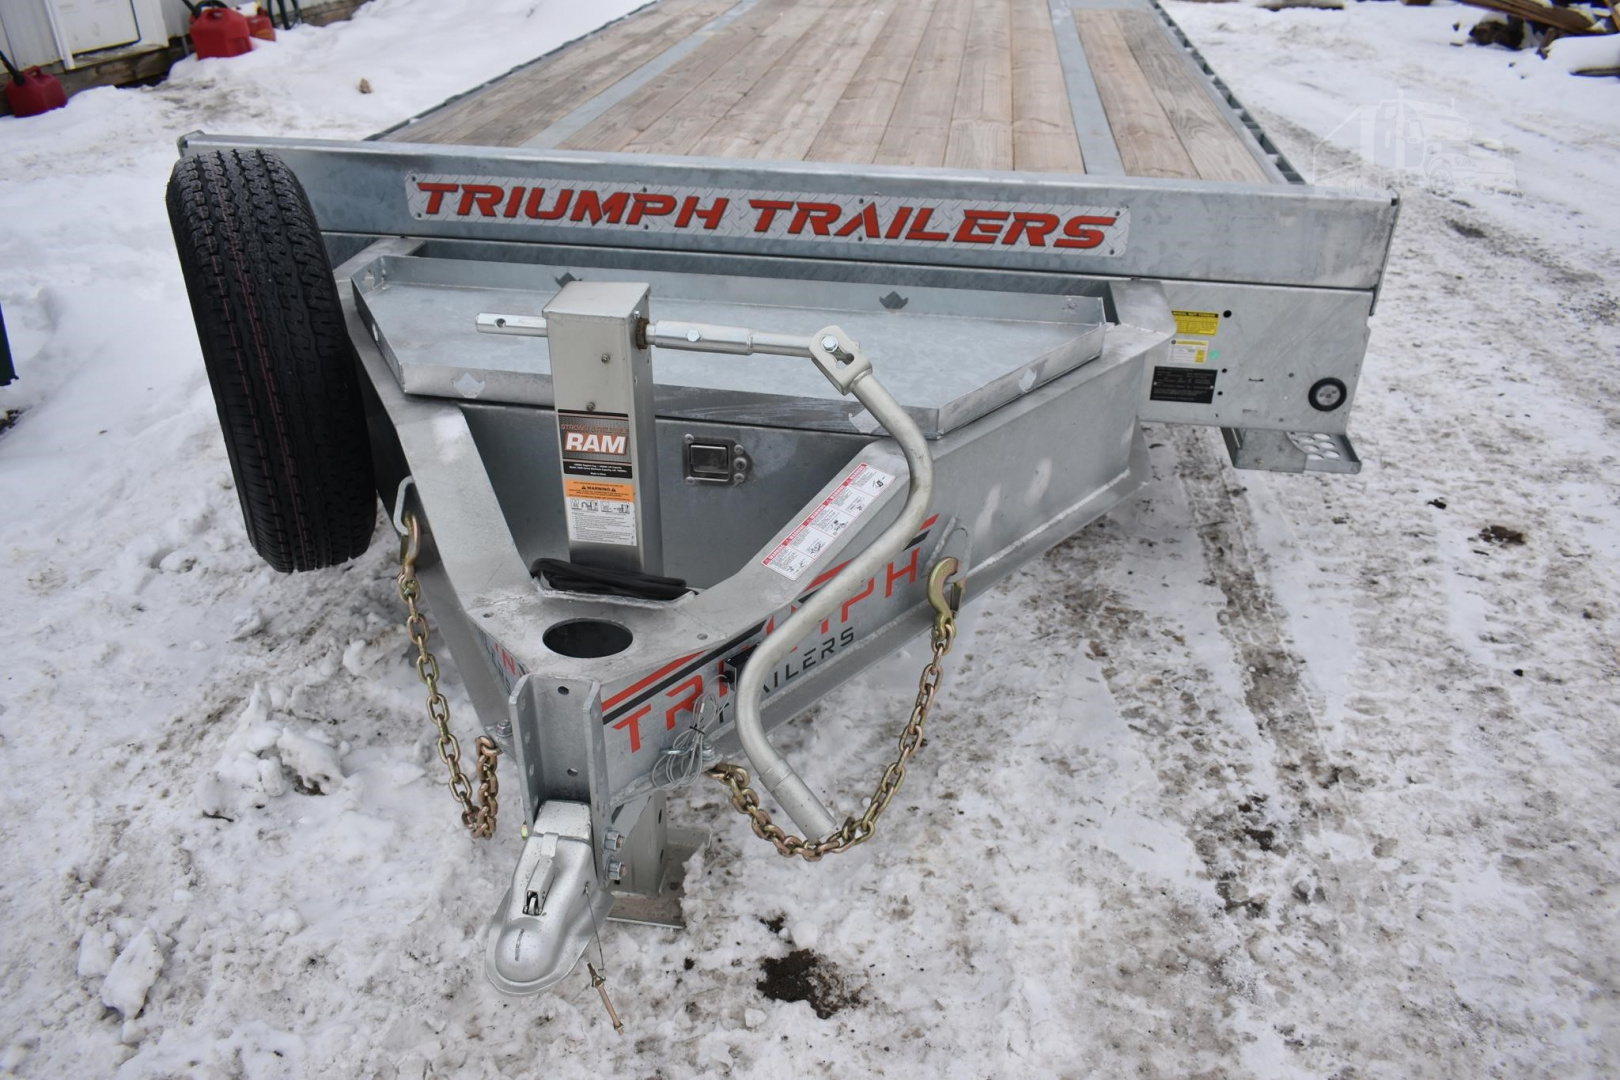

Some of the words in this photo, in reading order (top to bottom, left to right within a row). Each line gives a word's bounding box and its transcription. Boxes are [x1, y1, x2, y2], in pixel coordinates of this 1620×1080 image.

[417, 182, 730, 231] TRIUMPH
[749, 198, 1117, 250] TRAILERS
[565, 432, 626, 453] RAM
[612, 547, 920, 753] TRIPH
[715, 626, 855, 725] TILERS
